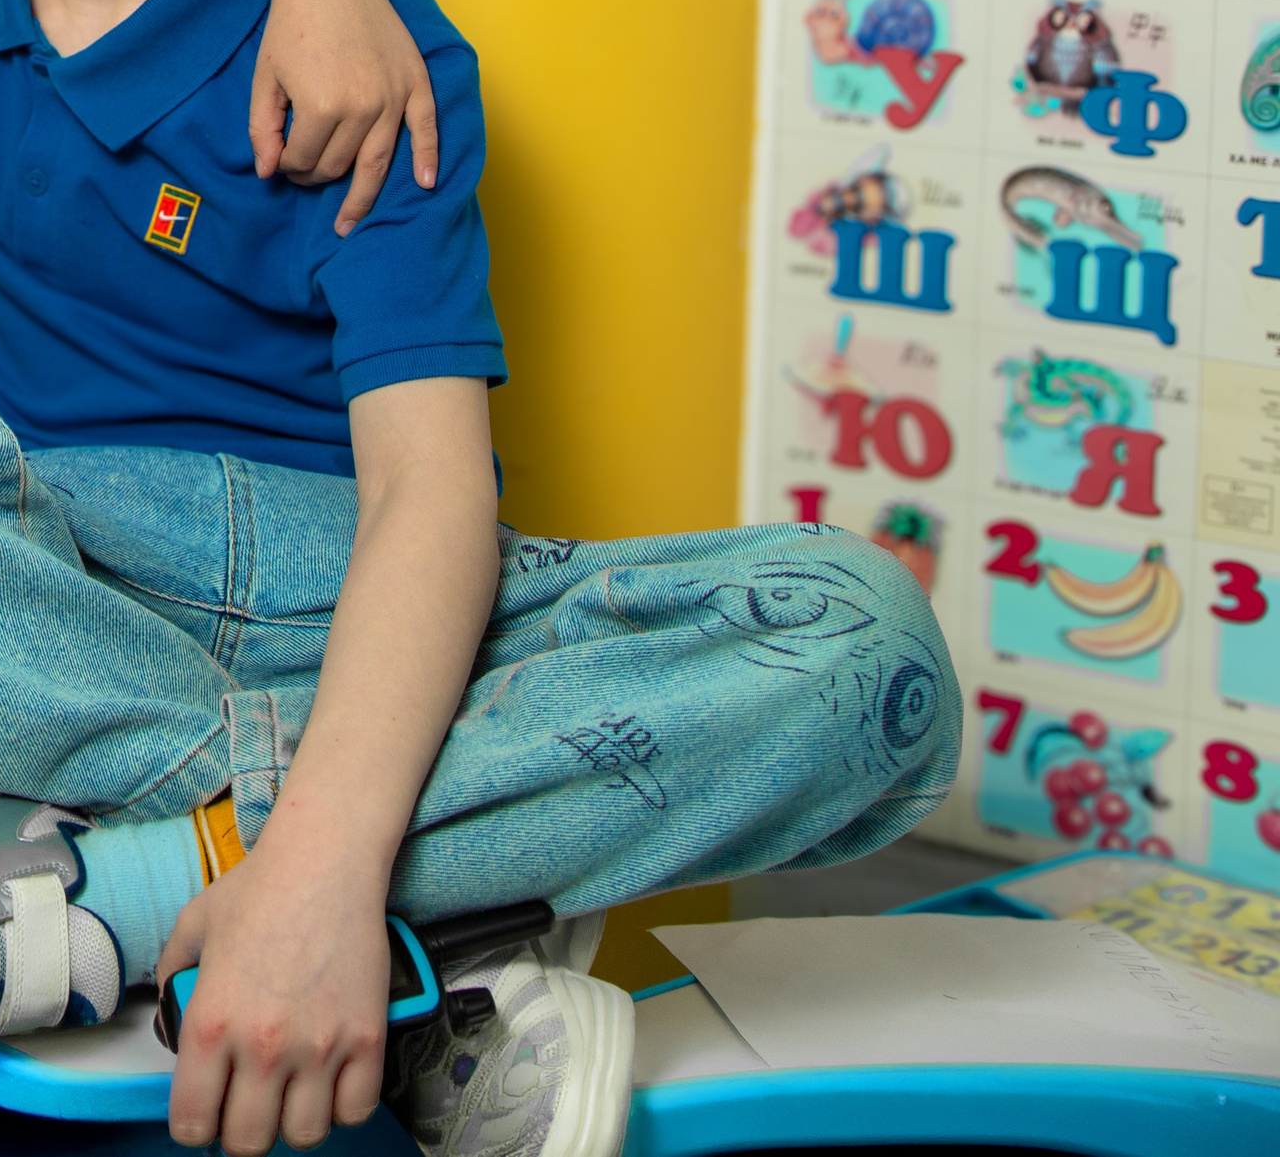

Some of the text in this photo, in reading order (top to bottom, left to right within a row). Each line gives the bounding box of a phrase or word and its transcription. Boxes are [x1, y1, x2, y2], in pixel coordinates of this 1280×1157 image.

[874, 47, 1188, 157] У Ф
[830, 218, 1179, 346] Ш Щ
[828, 390, 954, 481] Ю
[1069, 424, 1166, 517] Я
[984, 520, 1043, 587] 2
[1209, 560, 1269, 625] 3
[975, 688, 1260, 804] 7 8
